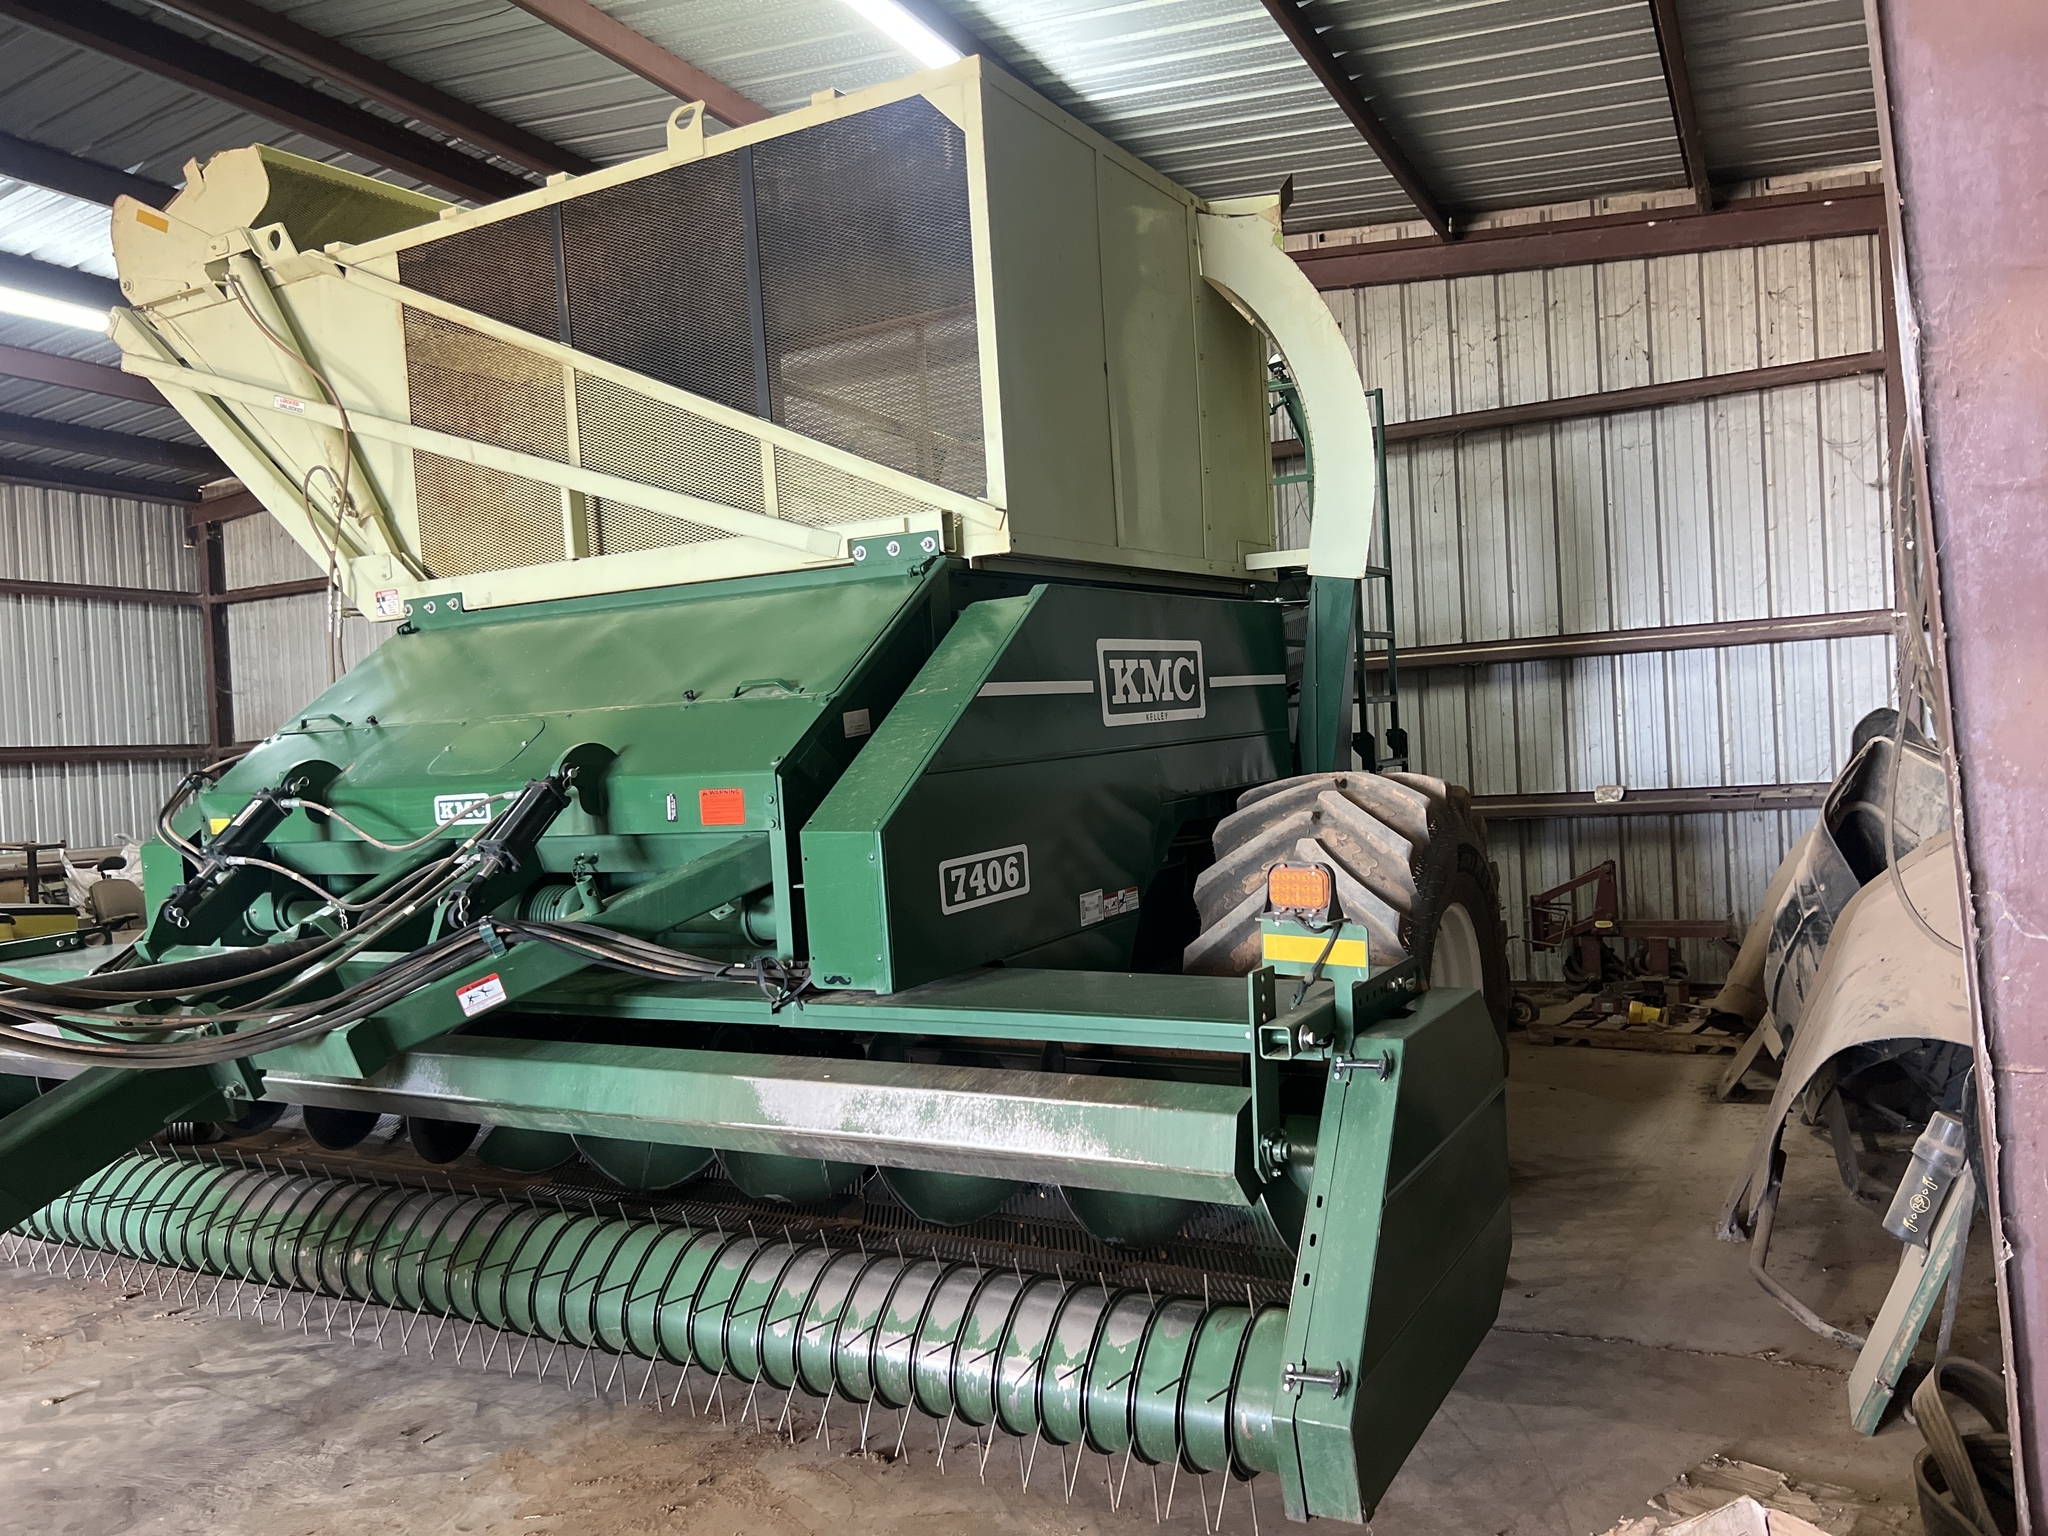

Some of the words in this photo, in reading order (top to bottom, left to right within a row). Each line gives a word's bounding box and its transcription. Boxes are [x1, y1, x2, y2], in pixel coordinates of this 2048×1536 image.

[279, 397, 300, 407] LOCKED
[279, 403, 303, 413] UNLOCKED
[1109, 657, 1195, 705] KMC
[1145, 712, 1169, 721] KELLEY
[439, 800, 485, 818] KMC
[951, 856, 1020, 902] 7406
